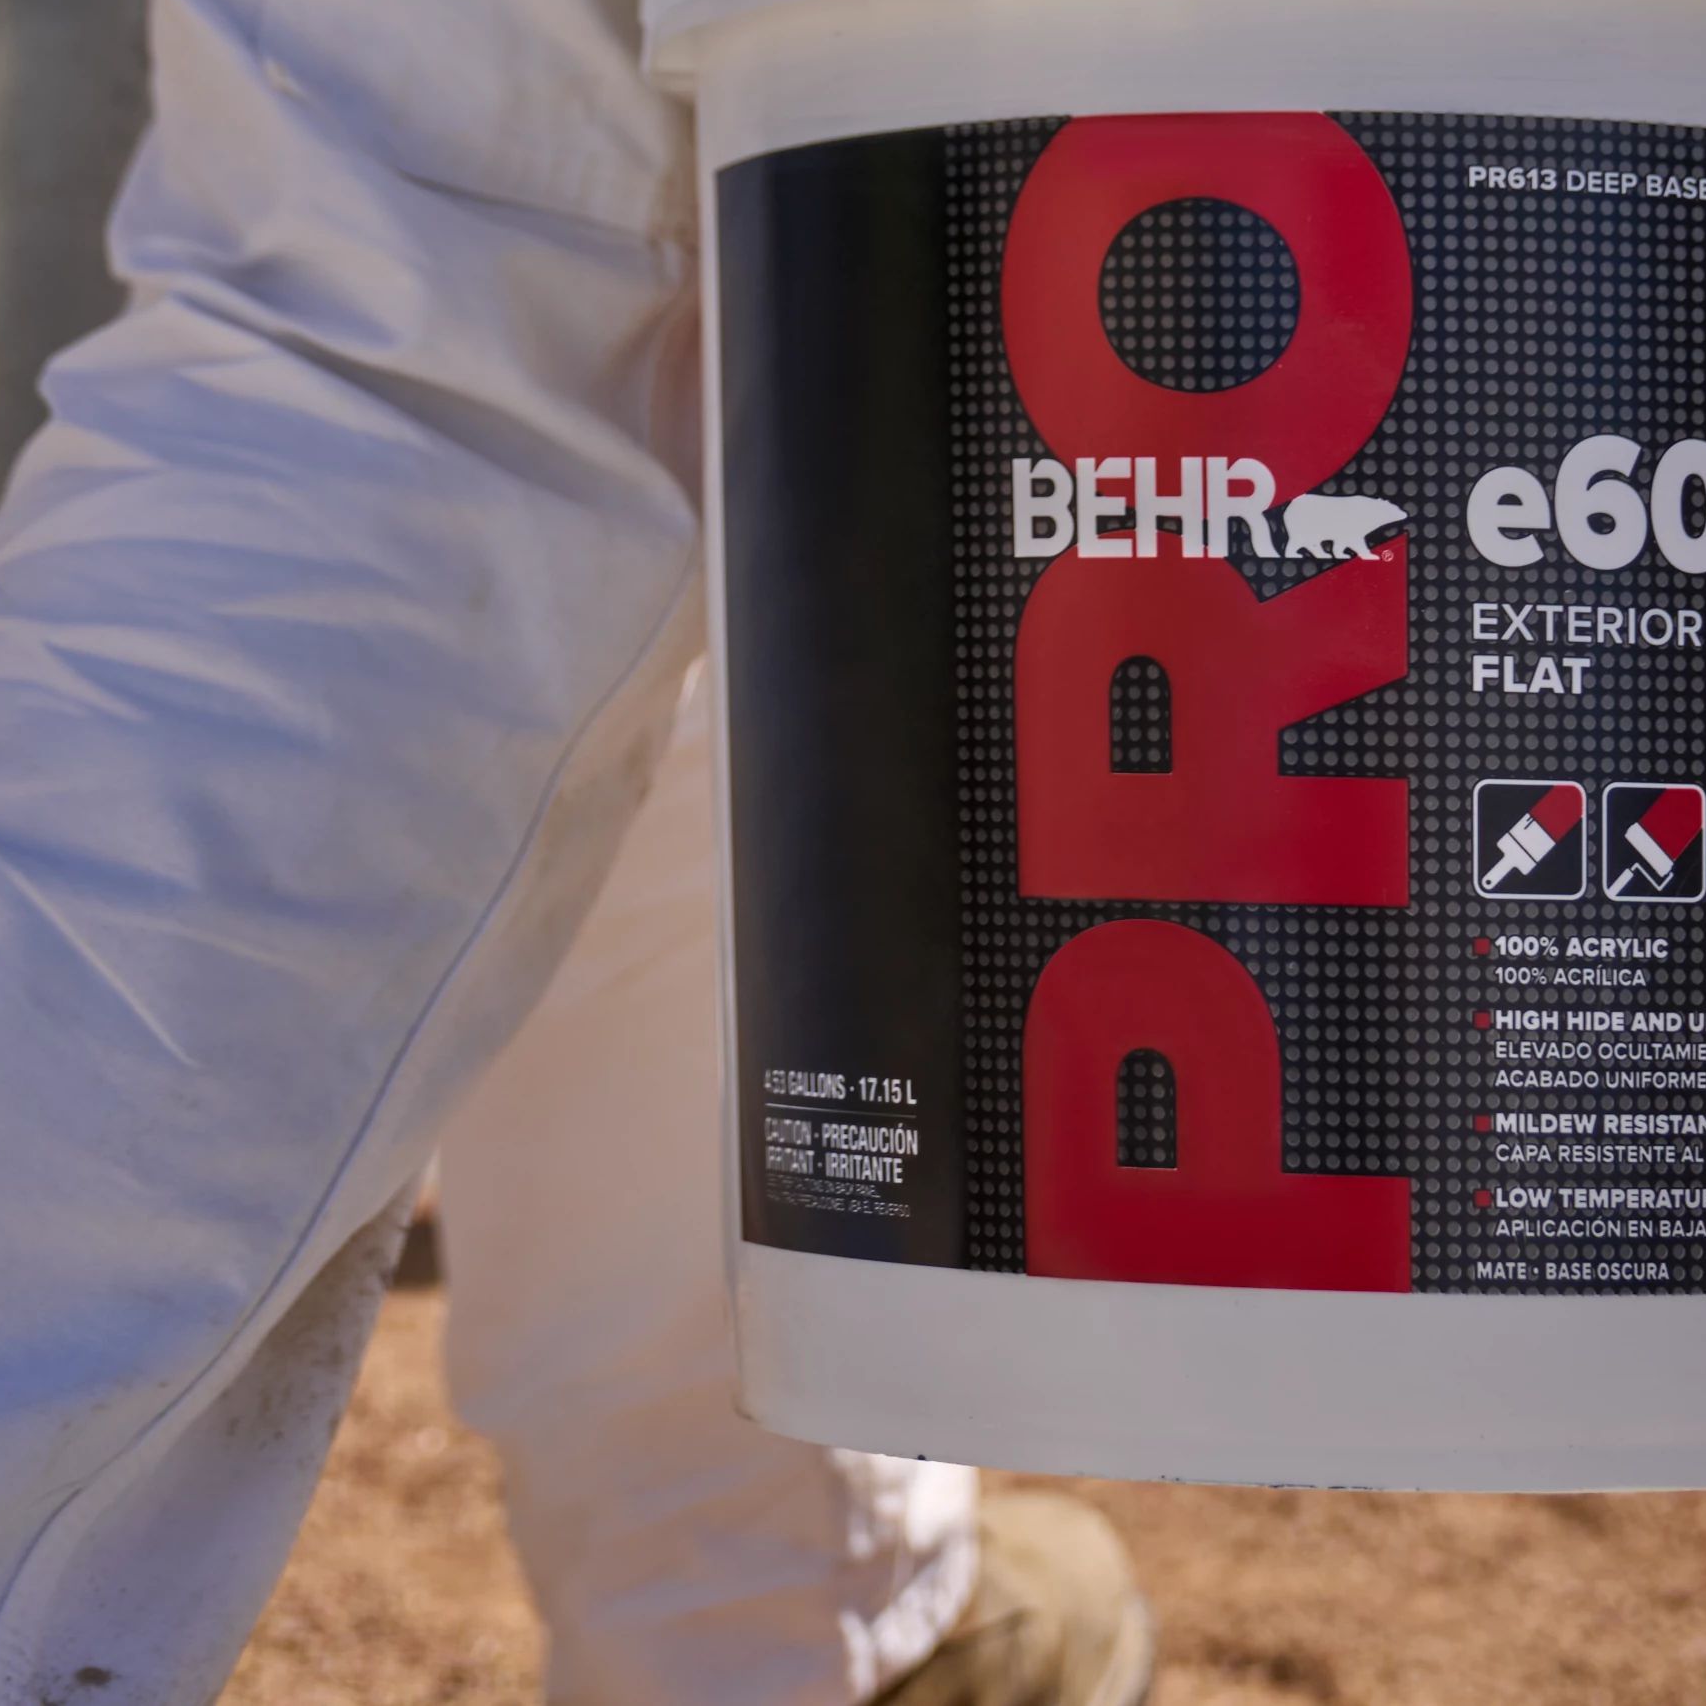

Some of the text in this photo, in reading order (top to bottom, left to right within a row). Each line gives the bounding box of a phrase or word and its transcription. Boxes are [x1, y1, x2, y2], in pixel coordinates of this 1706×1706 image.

[1468, 165, 1557, 191] PR613
[1566, 170, 1638, 194] DEEP
[1011, 456, 1282, 559] BEHR
[1471, 602, 1704, 648] EXTERIOR
[1472, 654, 1592, 695] FLAT
[1000, 110, 1414, 1294] PRO
[1495, 935, 1669, 960] 100% ACRYLIC
[1495, 964, 1647, 987] 100% ACRÍLICA
[1495, 1010, 1559, 1031] HIGH
[1566, 1011, 1625, 1032] HIDE
[1630, 1012, 1683, 1033] AND
[1495, 1041, 1592, 1061] ELEVADO
[859, 1076, 901, 1104] 17.15
[906, 1079, 918, 1105] L
[1495, 1069, 1599, 1089] ACABADO
[1495, 1113, 1596, 1135] MILDEW
[821, 1122, 919, 1156] PRECAUCIÓN
[1495, 1144, 1552, 1163] CAPA
[1557, 1144, 1676, 1164] RESISTENTE
[1681, 1145, 1704, 1164] AL
[824, 1151, 904, 1184] IRRITANTE
[1495, 1188, 1552, 1209] LOW
[1495, 1215, 1622, 1238] APLICACIÓN
[1627, 1220, 1654, 1238] EN
[1476, 1261, 1671, 1282] MATE BASE OSCURA
